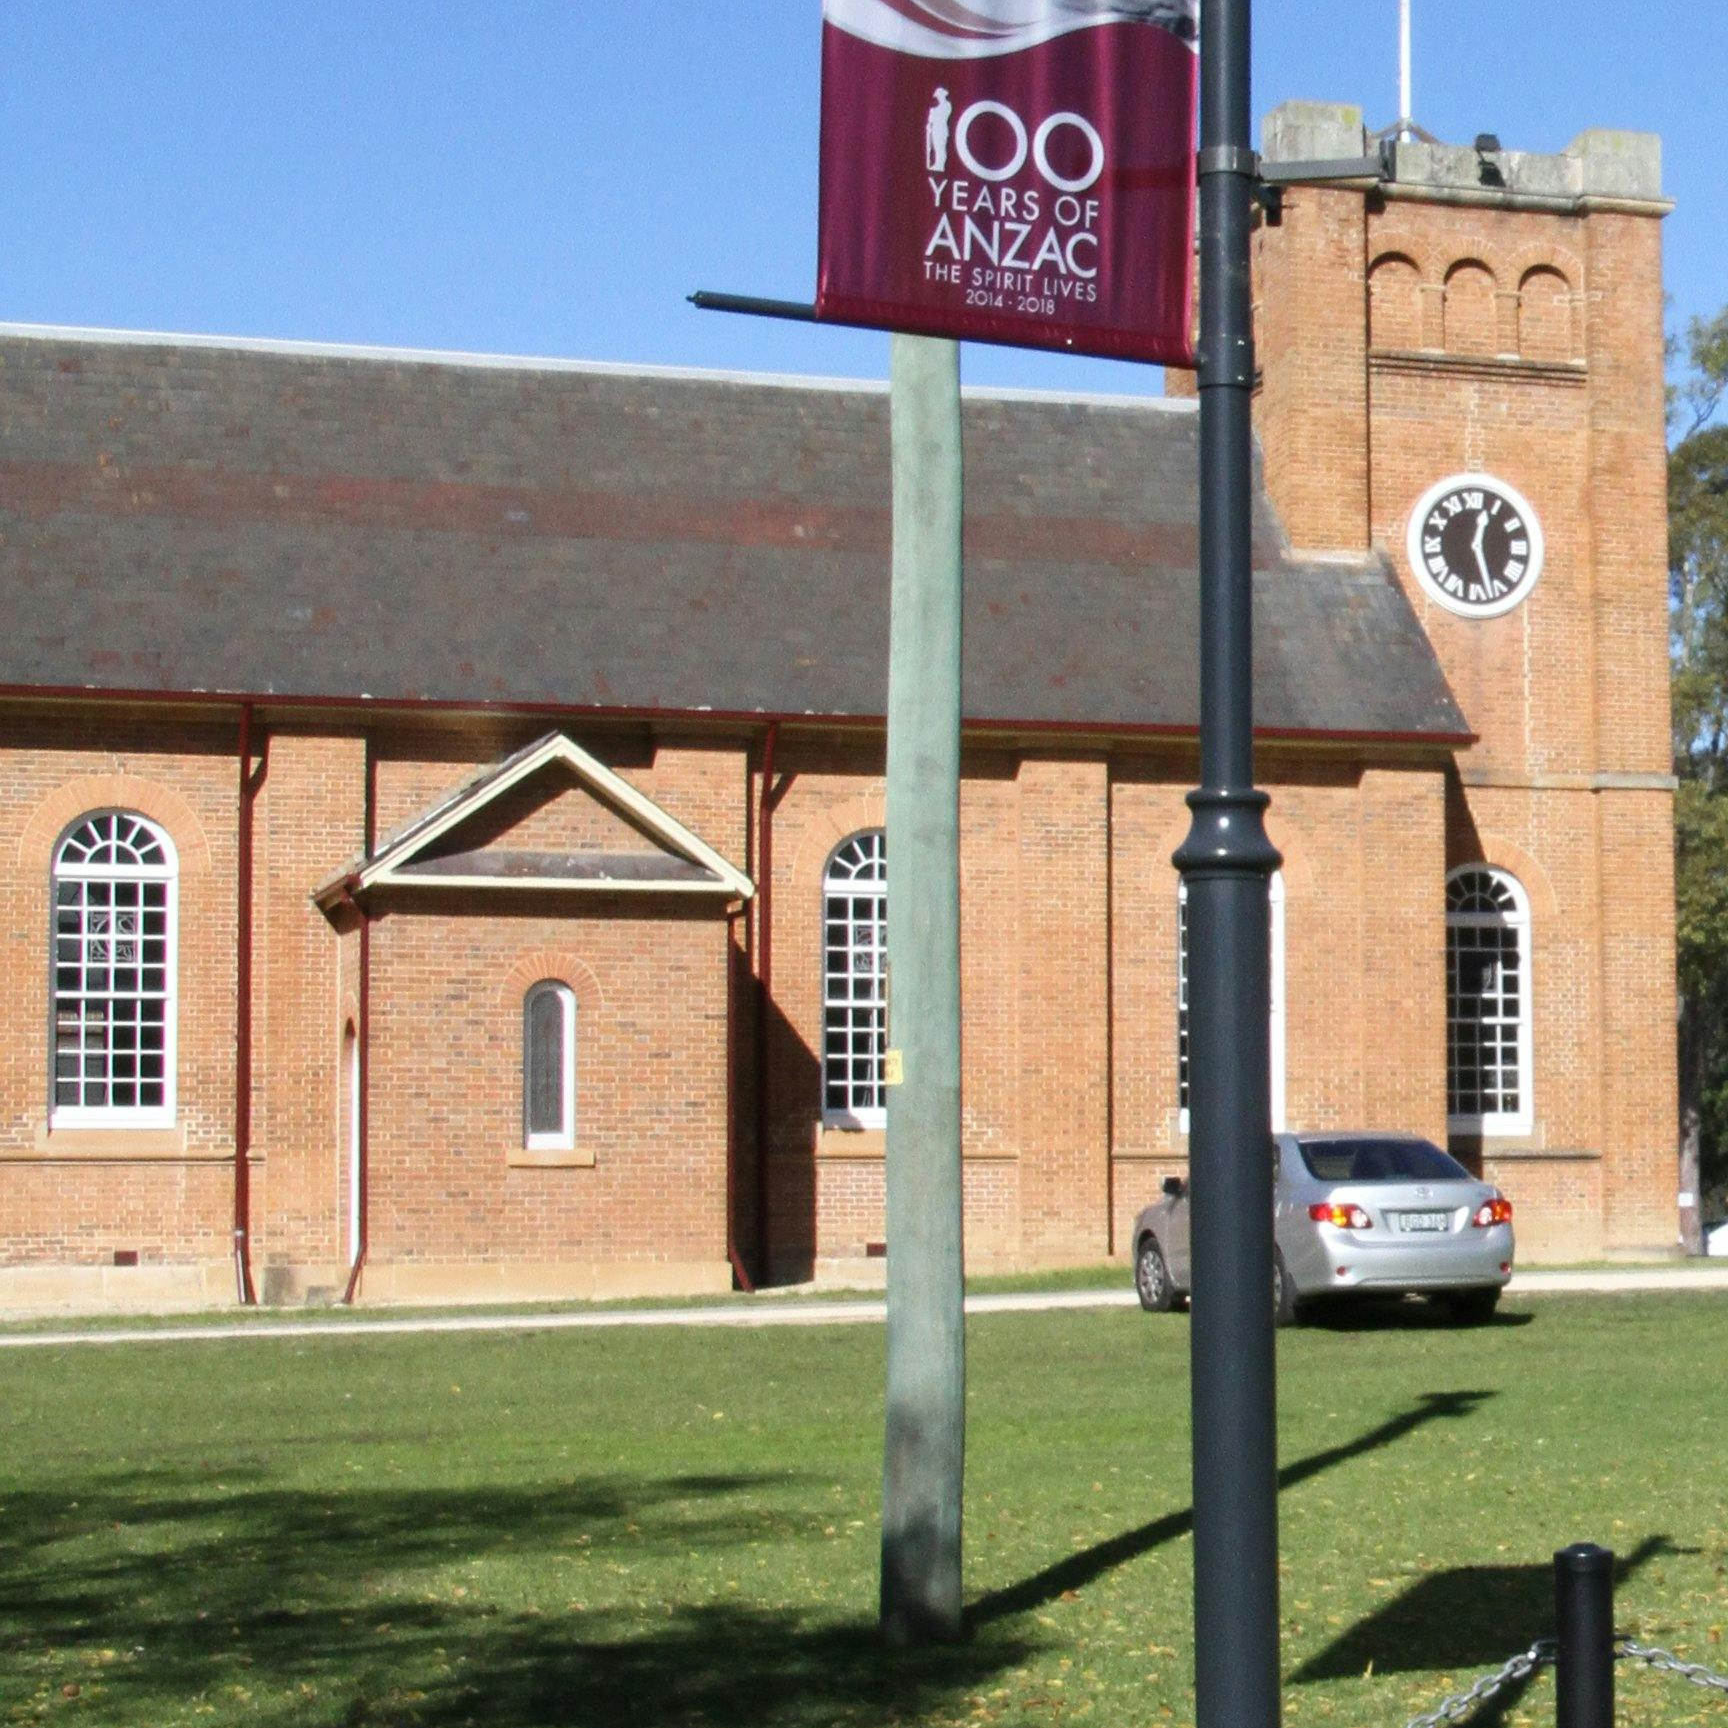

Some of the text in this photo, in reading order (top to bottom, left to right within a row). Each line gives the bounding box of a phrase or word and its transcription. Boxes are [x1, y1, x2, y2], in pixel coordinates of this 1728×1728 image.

[928, 176, 1100, 229] YEARS OF
[924, 212, 1098, 279] ANZAC
[924, 261, 1097, 303] THE SPIRIT LIVES
[966, 289, 1004, 308] 2014
[1016, 296, 1056, 315] 2018
[1429, 510, 1448, 532] X
[1491, 500, 1501, 515] I
